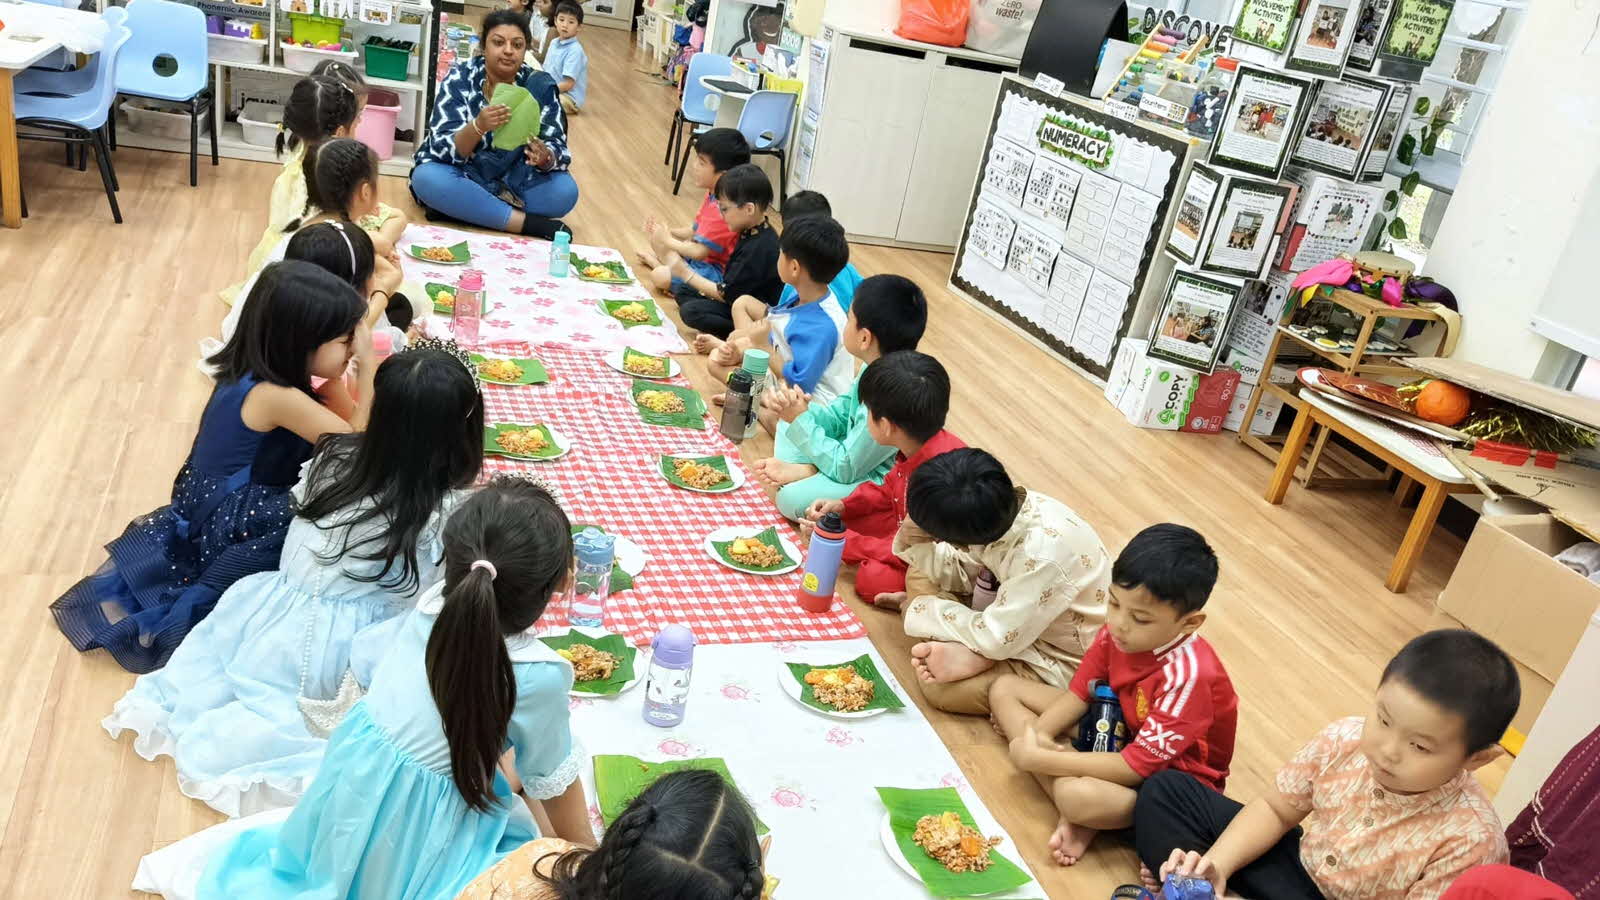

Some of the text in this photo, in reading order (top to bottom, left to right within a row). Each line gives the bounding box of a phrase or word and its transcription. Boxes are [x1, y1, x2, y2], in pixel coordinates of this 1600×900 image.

[197, 2, 236, 13] Phonemic
[996, 8, 1024, 20] waste!
[1416, 3, 1436, 15] FAMILY
[1253, 8, 1284, 22] ACTIVITIES
[1404, 12, 1441, 25] INVOLVEMENT
[1143, 7, 1234, 56] DISCOVE
[1403, 22, 1434, 35] ACTIVITIES
[1042, 126, 1106, 159] NUMERACY
[1240, 364, 1260, 375] COPY
[1164, 374, 1184, 410] COPY
